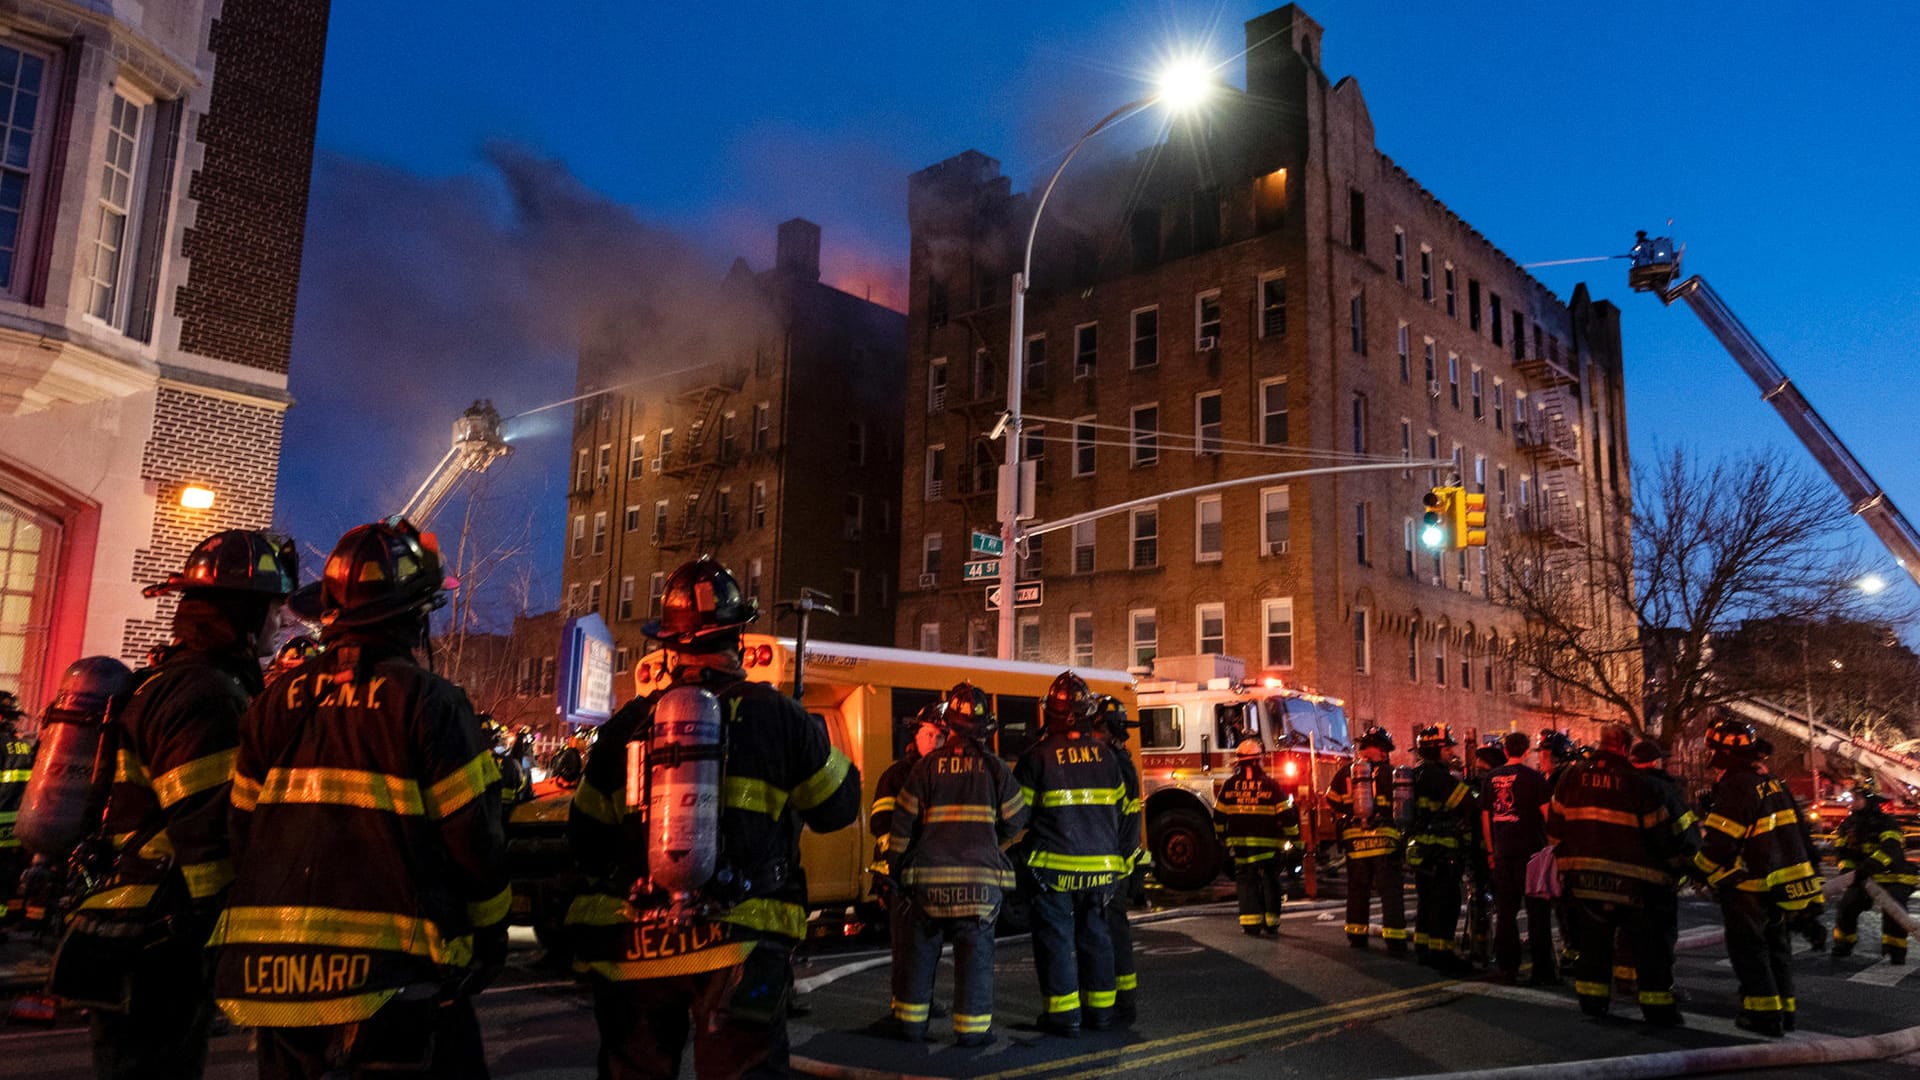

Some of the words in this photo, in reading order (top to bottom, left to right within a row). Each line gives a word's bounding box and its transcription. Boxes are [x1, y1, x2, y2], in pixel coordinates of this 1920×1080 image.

[980, 535, 986, 550] 7
[969, 565, 982, 576] 44
[986, 563, 996, 572] ST
[1057, 873, 1113, 891] WILLIAMS
[927, 886, 989, 904] COSTELLO
[244, 953, 371, 995] LEONARD
